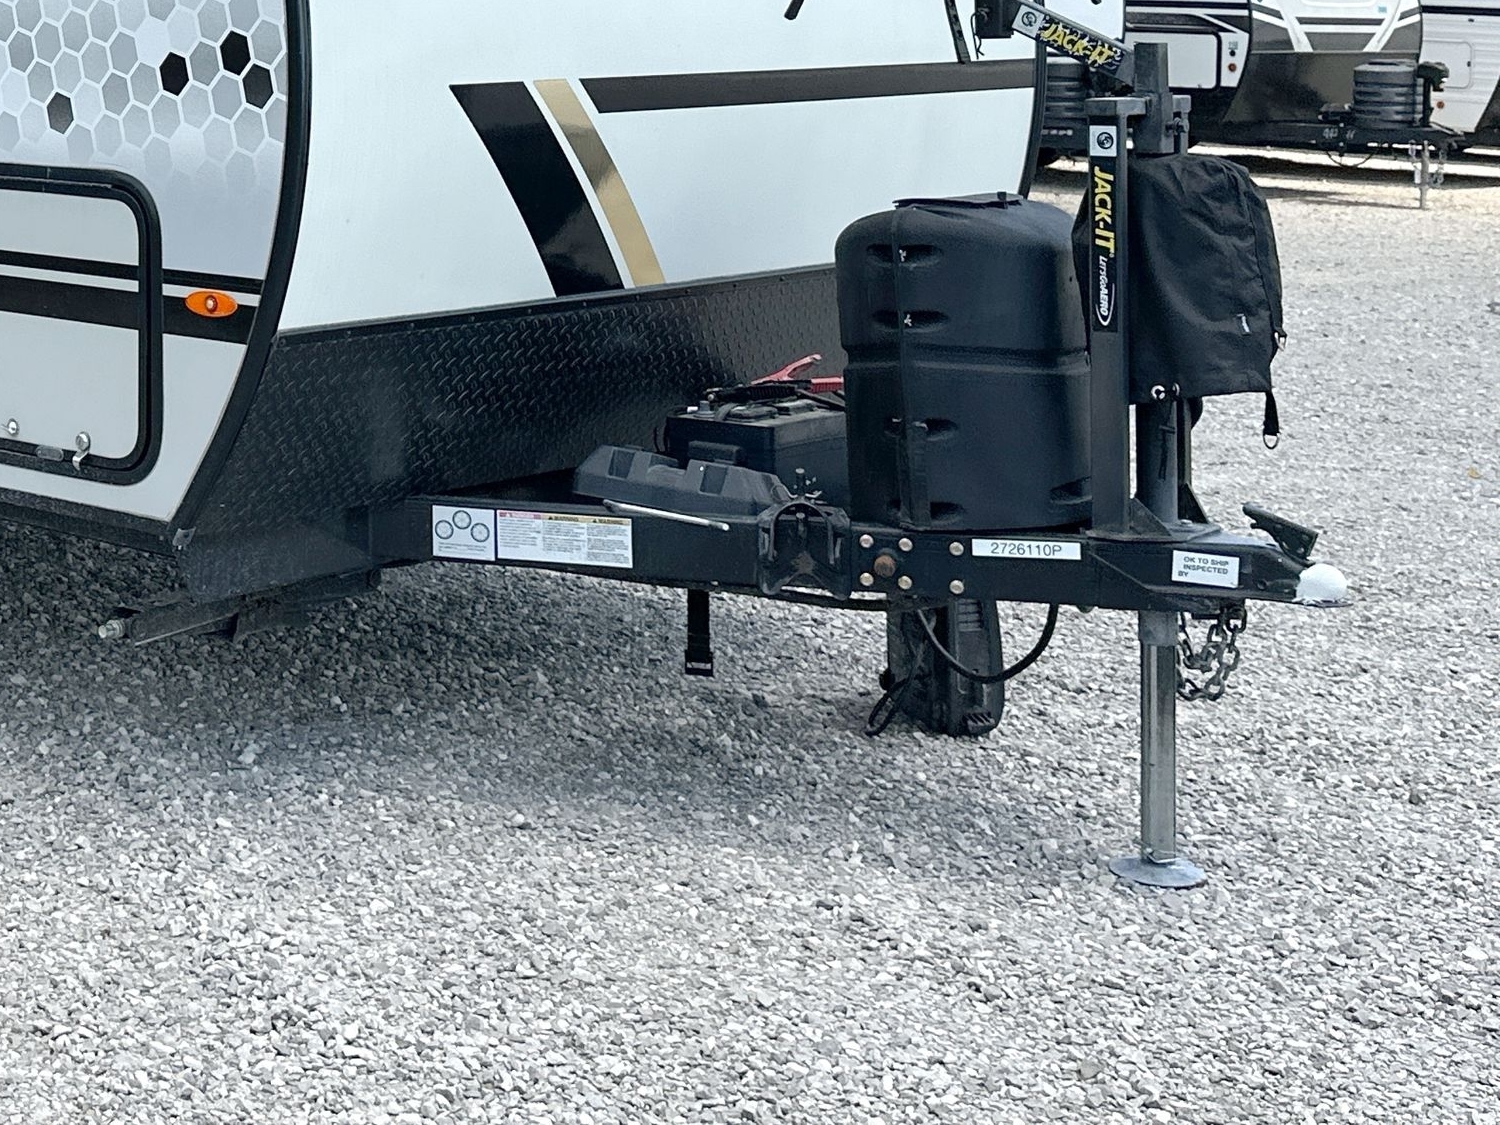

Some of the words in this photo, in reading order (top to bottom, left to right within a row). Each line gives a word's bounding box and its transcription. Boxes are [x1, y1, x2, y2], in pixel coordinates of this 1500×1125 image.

[1040, 23, 1114, 65] JACK-IT
[1094, 165, 1115, 253] JACK-IT
[990, 542, 1062, 556] 2726110P
[1197, 557, 1209, 565] TO
[1210, 559, 1229, 567] SHIP
[1183, 564, 1229, 575] INSPECTED
